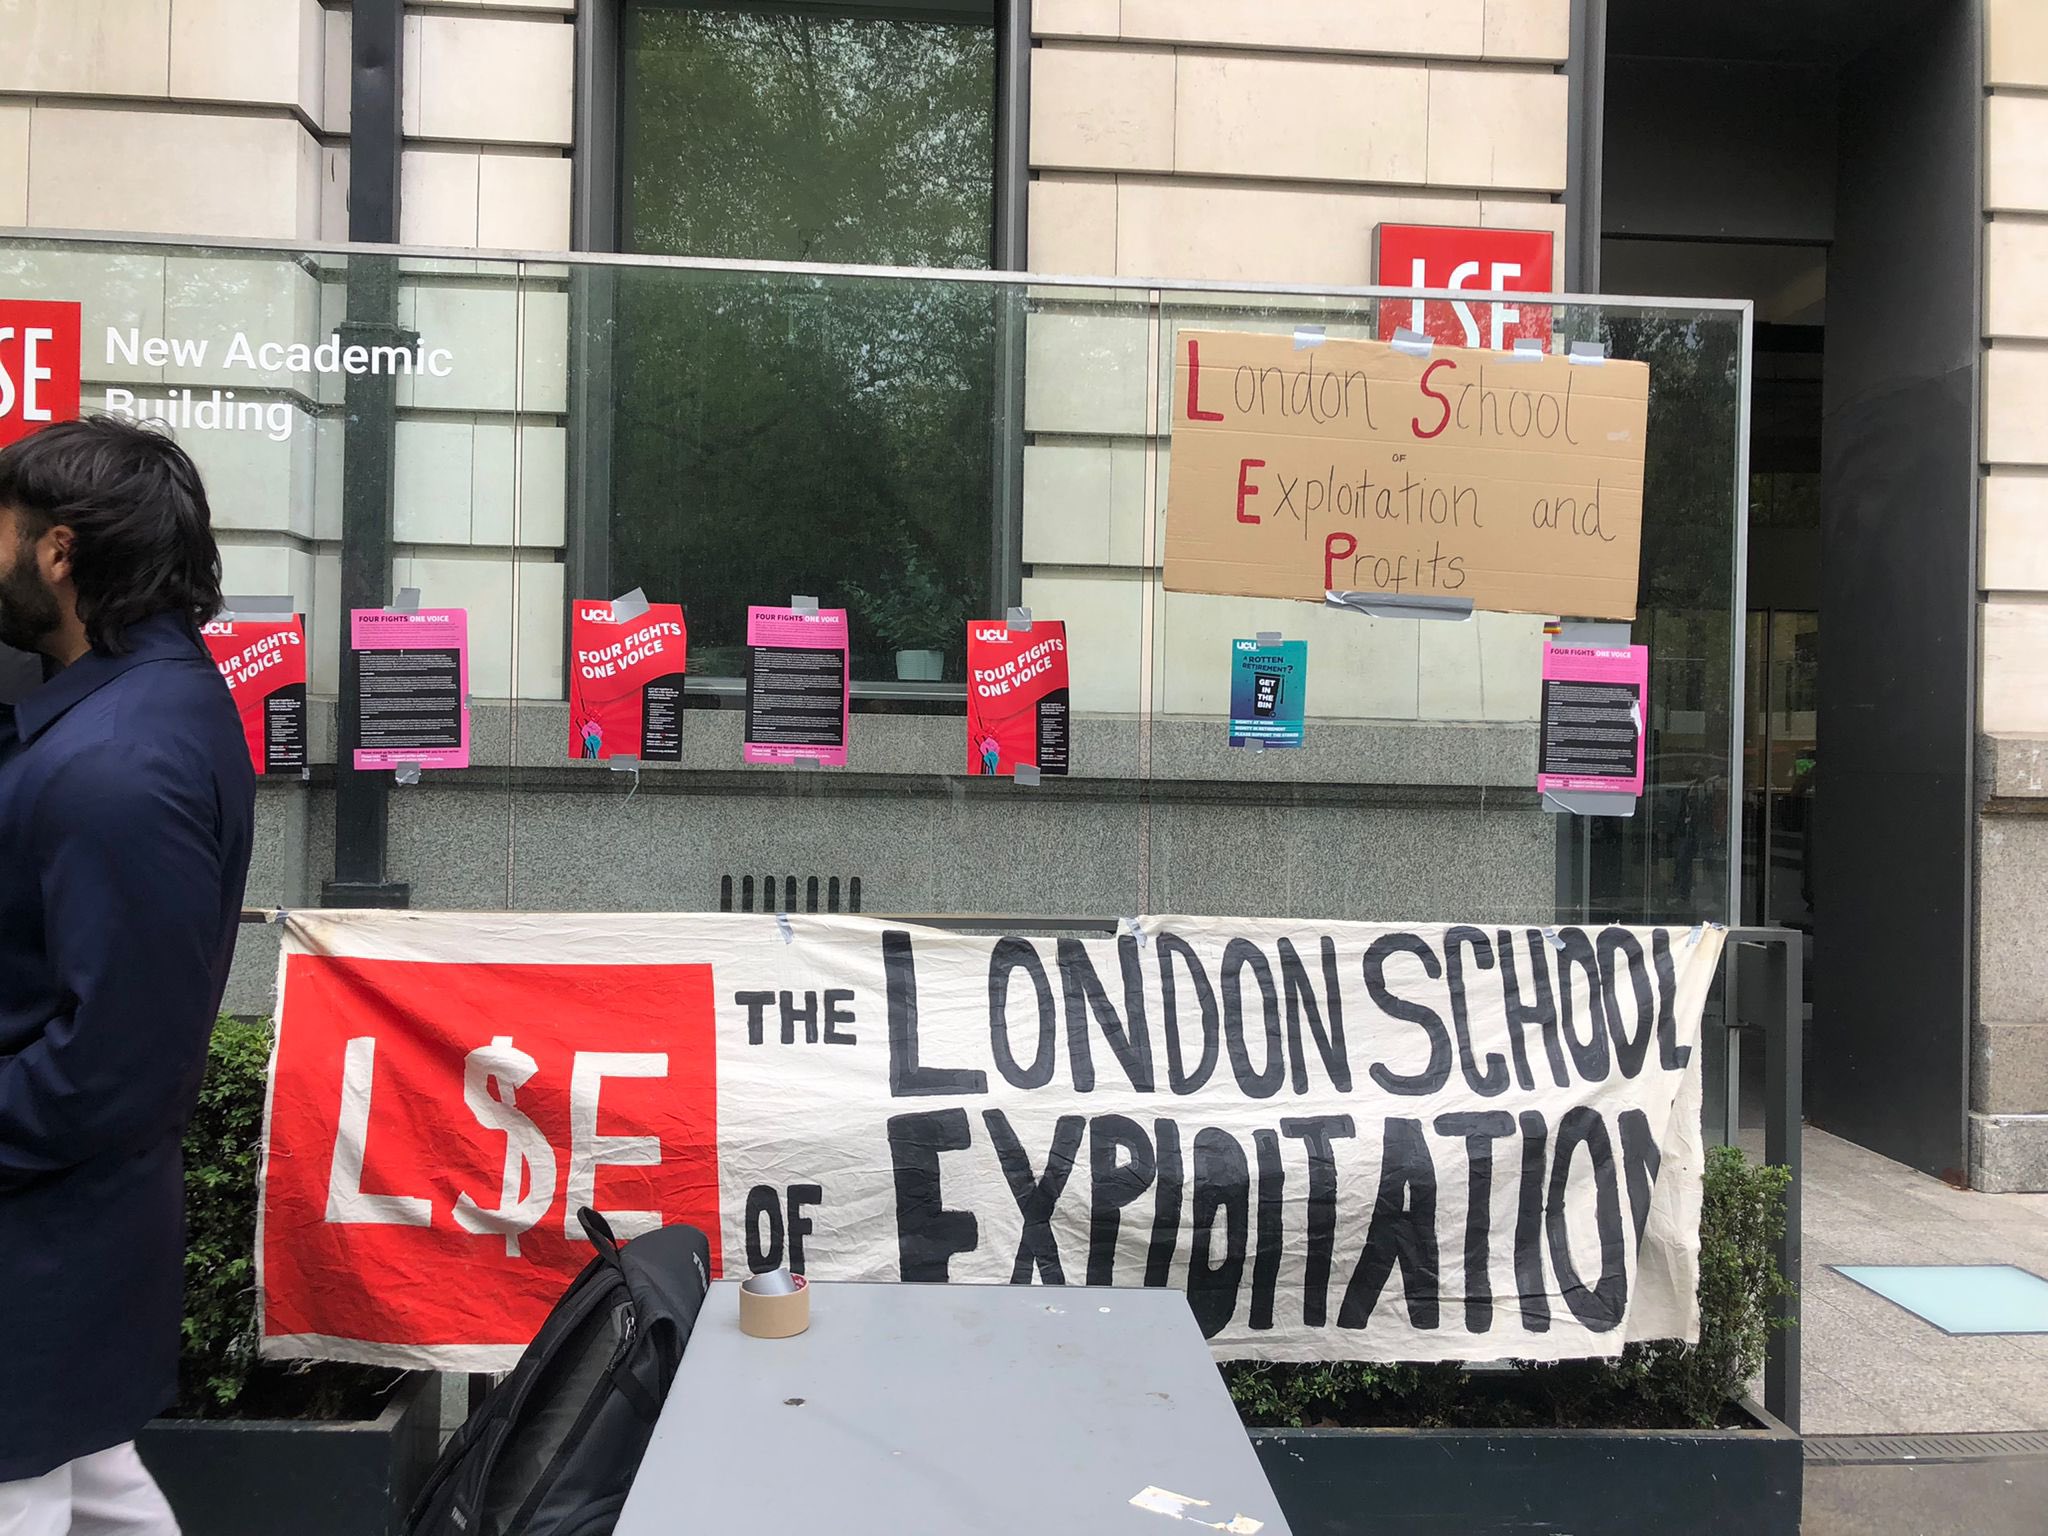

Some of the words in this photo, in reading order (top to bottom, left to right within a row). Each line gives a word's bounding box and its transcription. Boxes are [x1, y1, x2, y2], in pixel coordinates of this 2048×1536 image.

[106, 326, 208, 368] New
[223, 332, 453, 377] Academic
[1186, 340, 1377, 432] London
[1411, 358, 1579, 446] School
[105, 388, 292, 441] Building
[1391, 453, 1407, 463] OF
[1236, 458, 1483, 541] Exploitation
[1533, 477, 1616, 542] and
[1324, 532, 1466, 595] Profits
[777, 614, 803, 622] FIGHTS
[218, 656, 243, 675] UR
[242, 631, 300, 663] FIGHTS
[578, 643, 623, 664] FOUR
[624, 622, 681, 650] FIGHTS
[581, 662, 616, 679] ONE
[616, 639, 664, 670] VOICE
[974, 661, 1016, 682] FOUR
[1017, 638, 1064, 668] FIGHTS
[1248, 656, 1284, 664] ROTTEN
[236, 649, 283, 684] VOICE
[978, 680, 1011, 697] ONE
[1011, 655, 1053, 688] VOICE
[1242, 662, 1294, 674] RETIREMENT?
[1259, 679, 1276, 687] GET
[1257, 693, 1274, 702] THE
[1257, 701, 1272, 709] BIN
[734, 990, 858, 1046] THE
[882, 930, 1353, 1099] LONDON
[1363, 926, 1691, 1098] SCHOOL
[325, 1035, 668, 1258] L$E
[744, 1184, 823, 1274] OF
